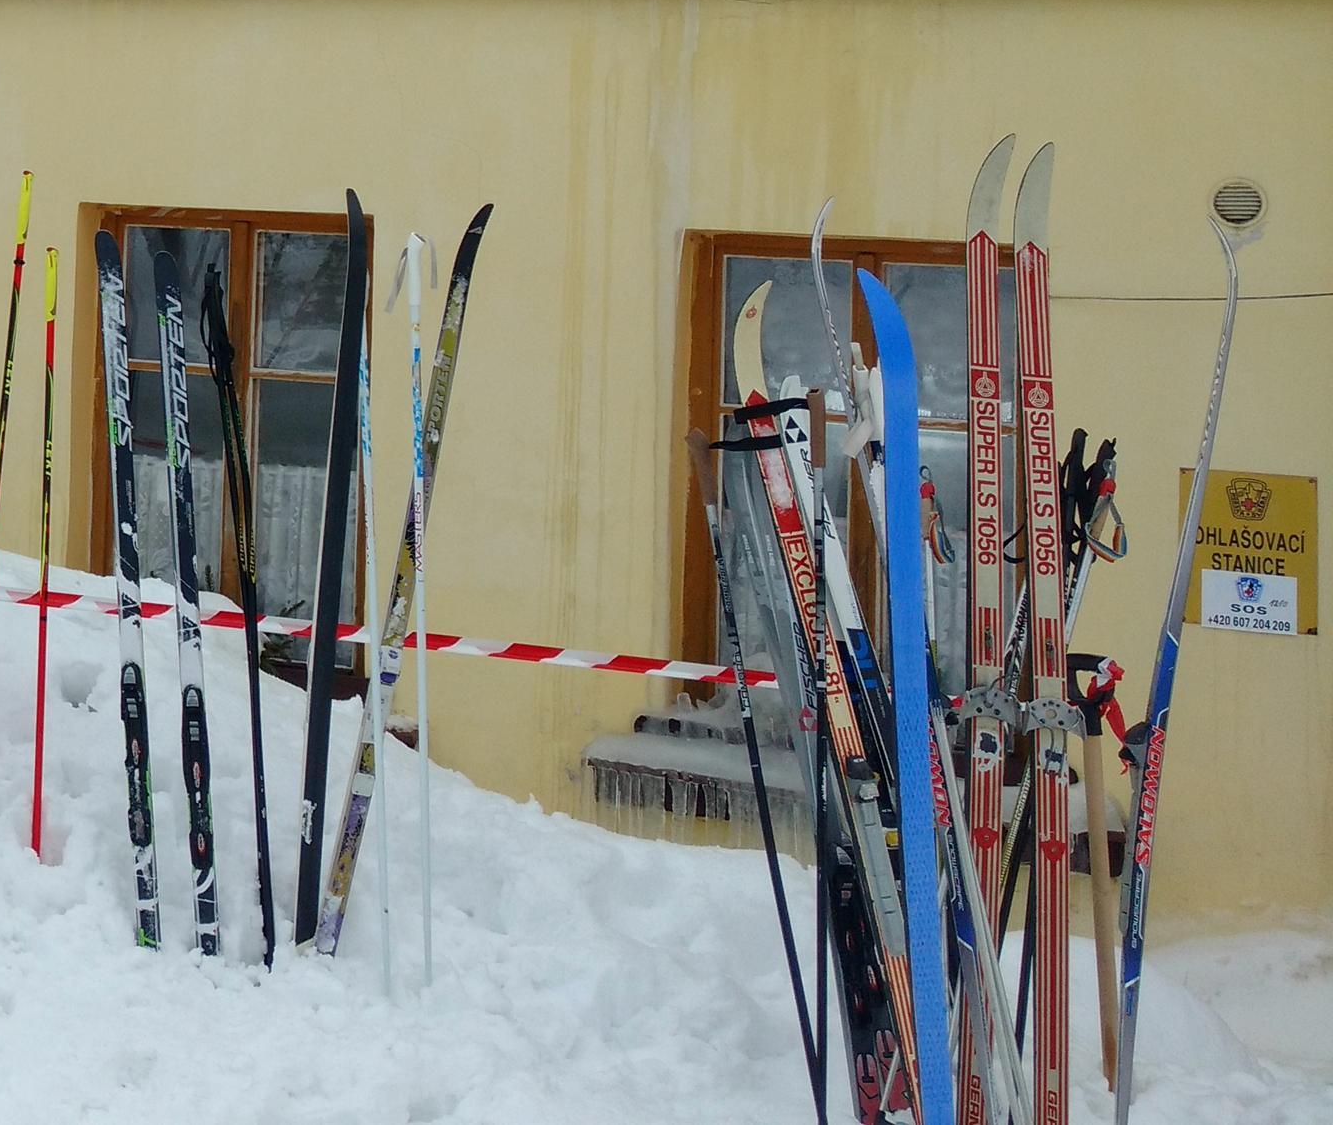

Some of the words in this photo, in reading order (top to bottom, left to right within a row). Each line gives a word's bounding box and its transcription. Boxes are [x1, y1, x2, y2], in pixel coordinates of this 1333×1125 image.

[165, 293, 192, 475] SPORTEN
[976, 401, 996, 474] SUPER
[1029, 410, 1052, 485] SUPER
[977, 480, 997, 507] LS
[1033, 490, 1055, 518] LS
[414, 491, 423, 573] MASTERS
[977, 515, 997, 565] 1056
[1034, 525, 1056, 576] 1056
[1195, 525, 1305, 554] OHLAŠOVACÍ
[1211, 552, 1285, 576] STANICE
[1208, 614, 1230, 625] +420
[1233, 616, 1250, 627] 607
[1253, 618, 1270, 629] 204
[1272, 620, 1290, 632] 209
[1230, 603, 1267, 615] SOS
[793, 621, 817, 711] FISCHER
[1134, 725, 1166, 867] SALOMON
